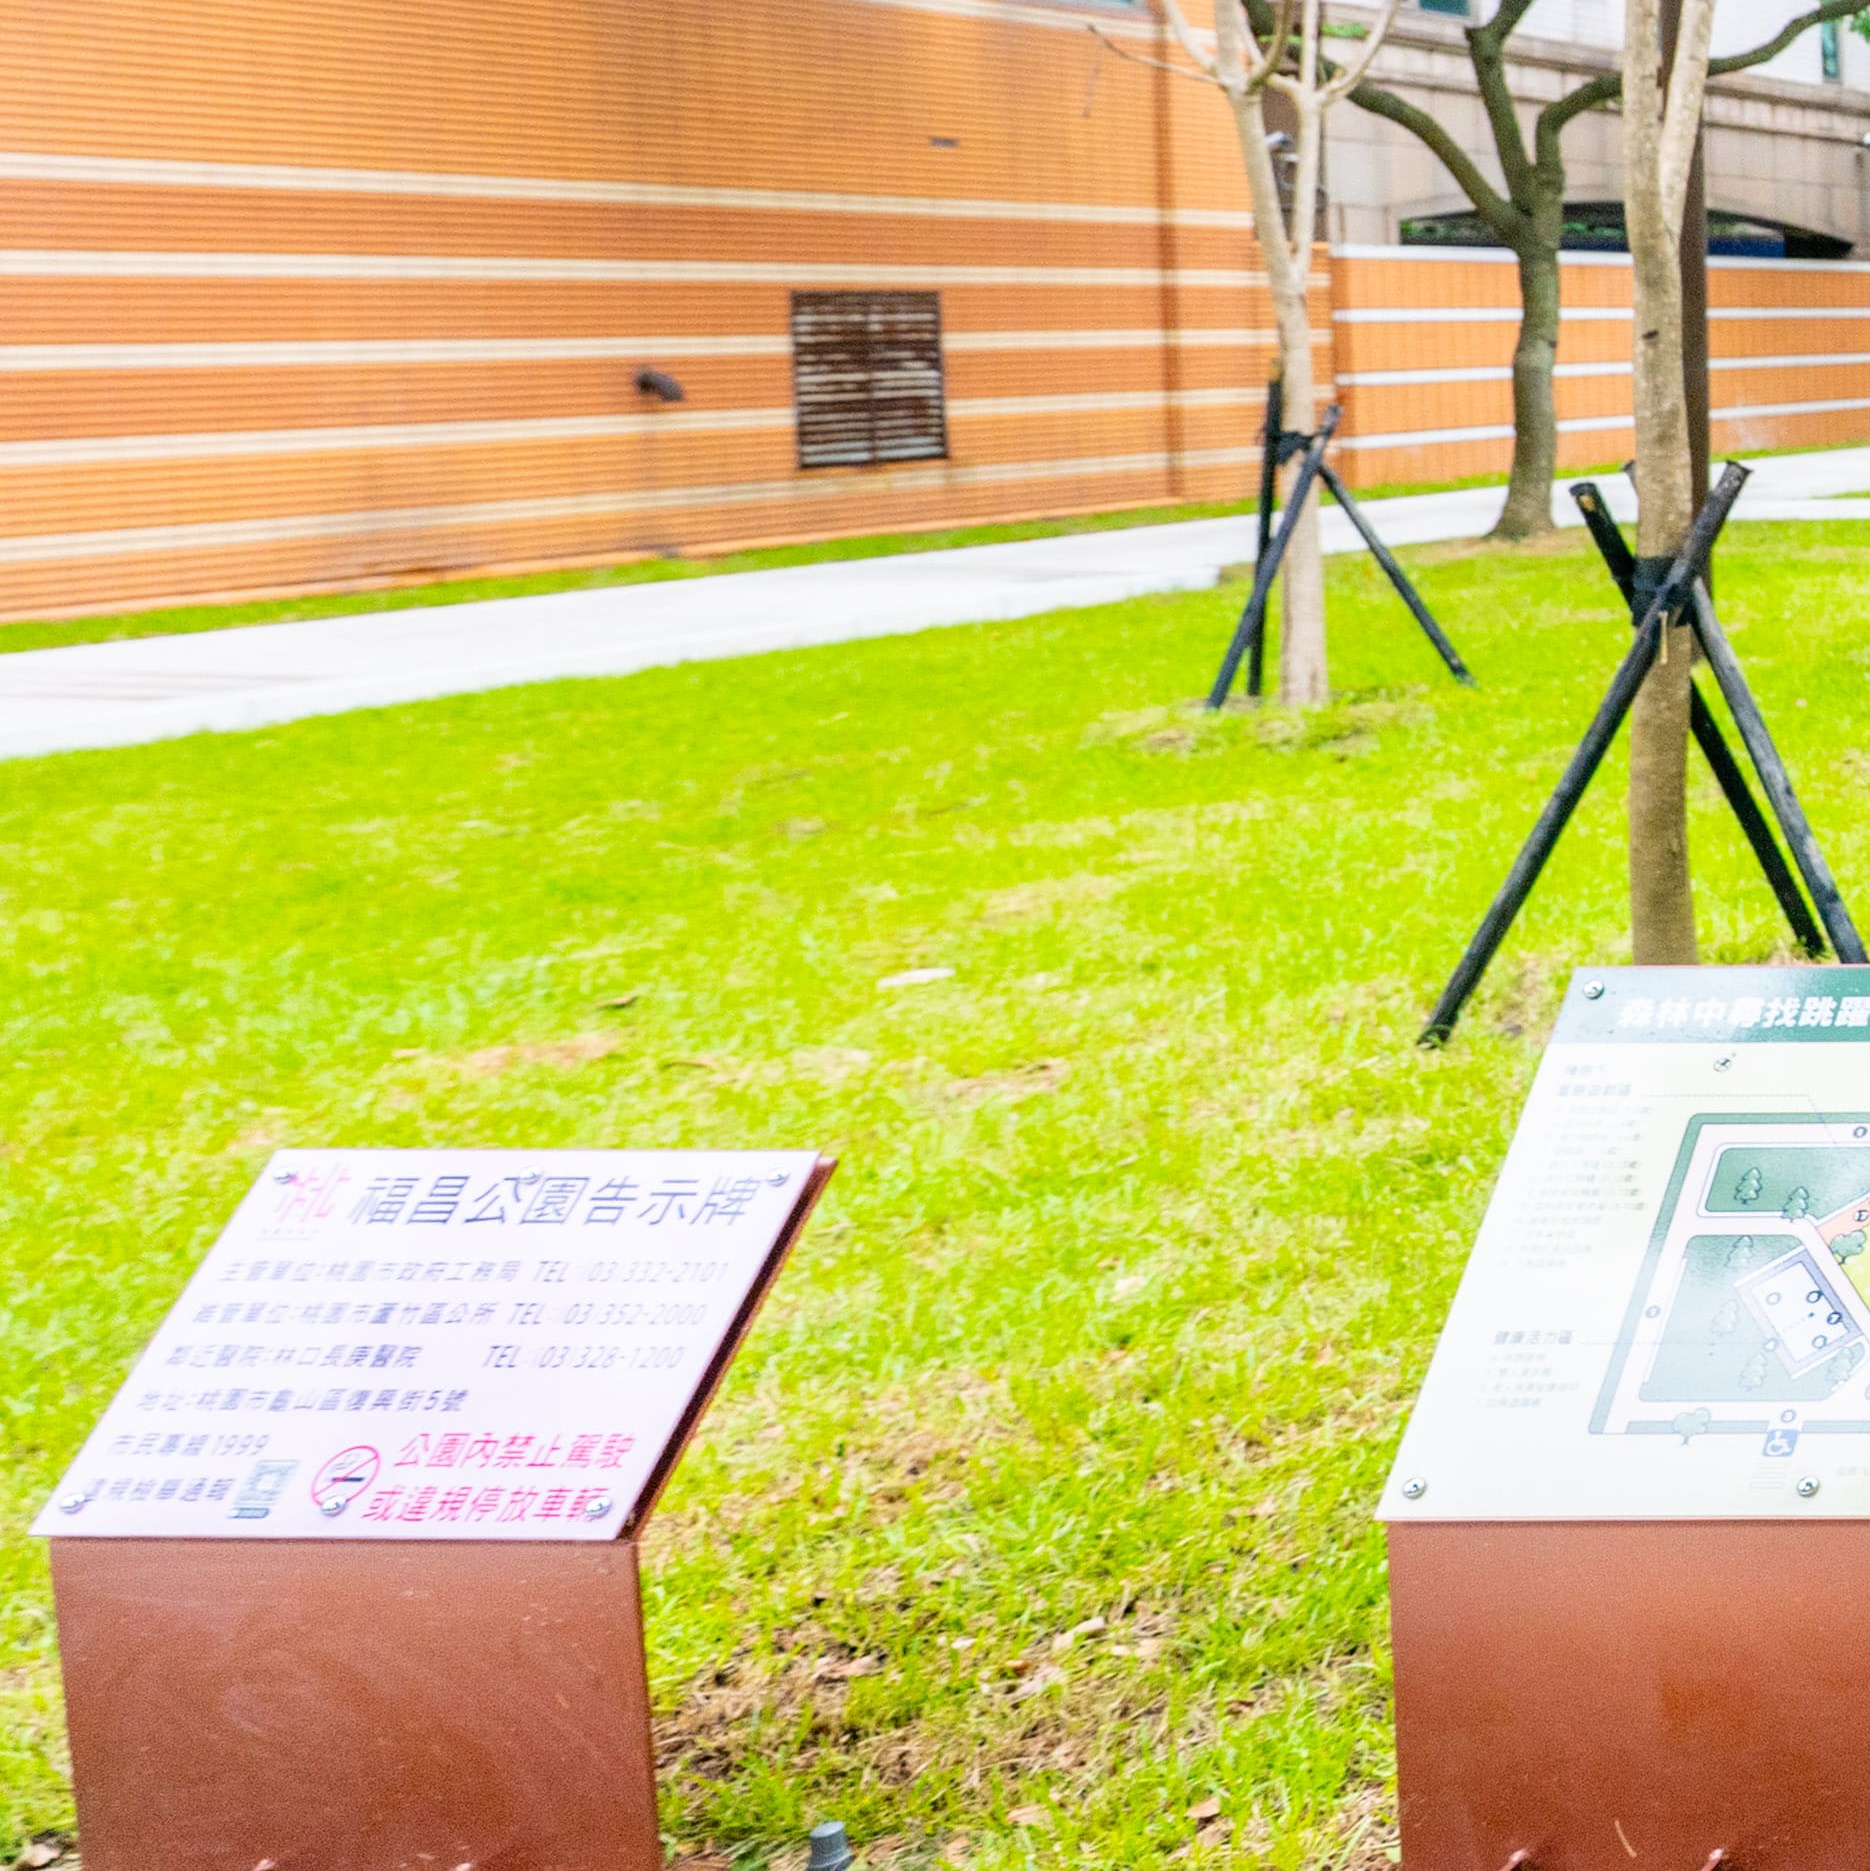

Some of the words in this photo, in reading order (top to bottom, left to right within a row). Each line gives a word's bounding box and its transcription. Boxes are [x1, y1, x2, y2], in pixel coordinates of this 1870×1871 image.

[348, 1175, 761, 1226] 福昌公園告示牌
[394, 1433, 636, 1469] 公園內禁止駕駛
